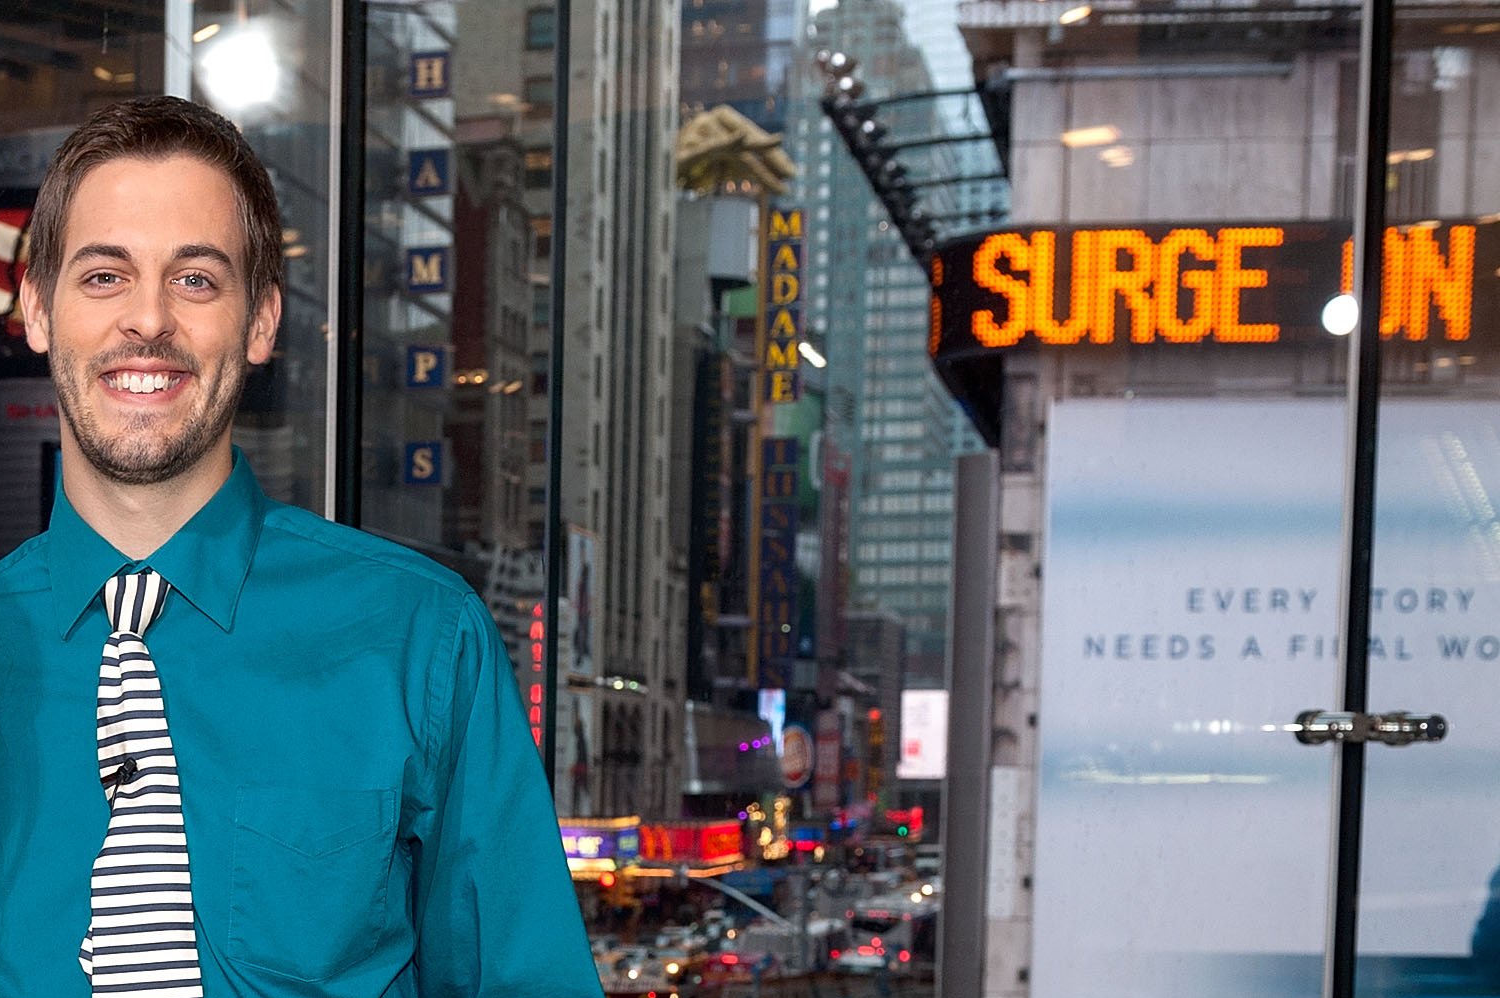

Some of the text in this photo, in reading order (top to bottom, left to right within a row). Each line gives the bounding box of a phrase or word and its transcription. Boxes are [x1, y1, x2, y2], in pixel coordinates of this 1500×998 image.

[767, 208, 803, 403] MADAME
[972, 227, 1284, 347] SURGE
[1186, 587, 1476, 614] EVERY TORY
[1083, 633, 1217, 661] NEEDS
[1241, 633, 1264, 660] A
